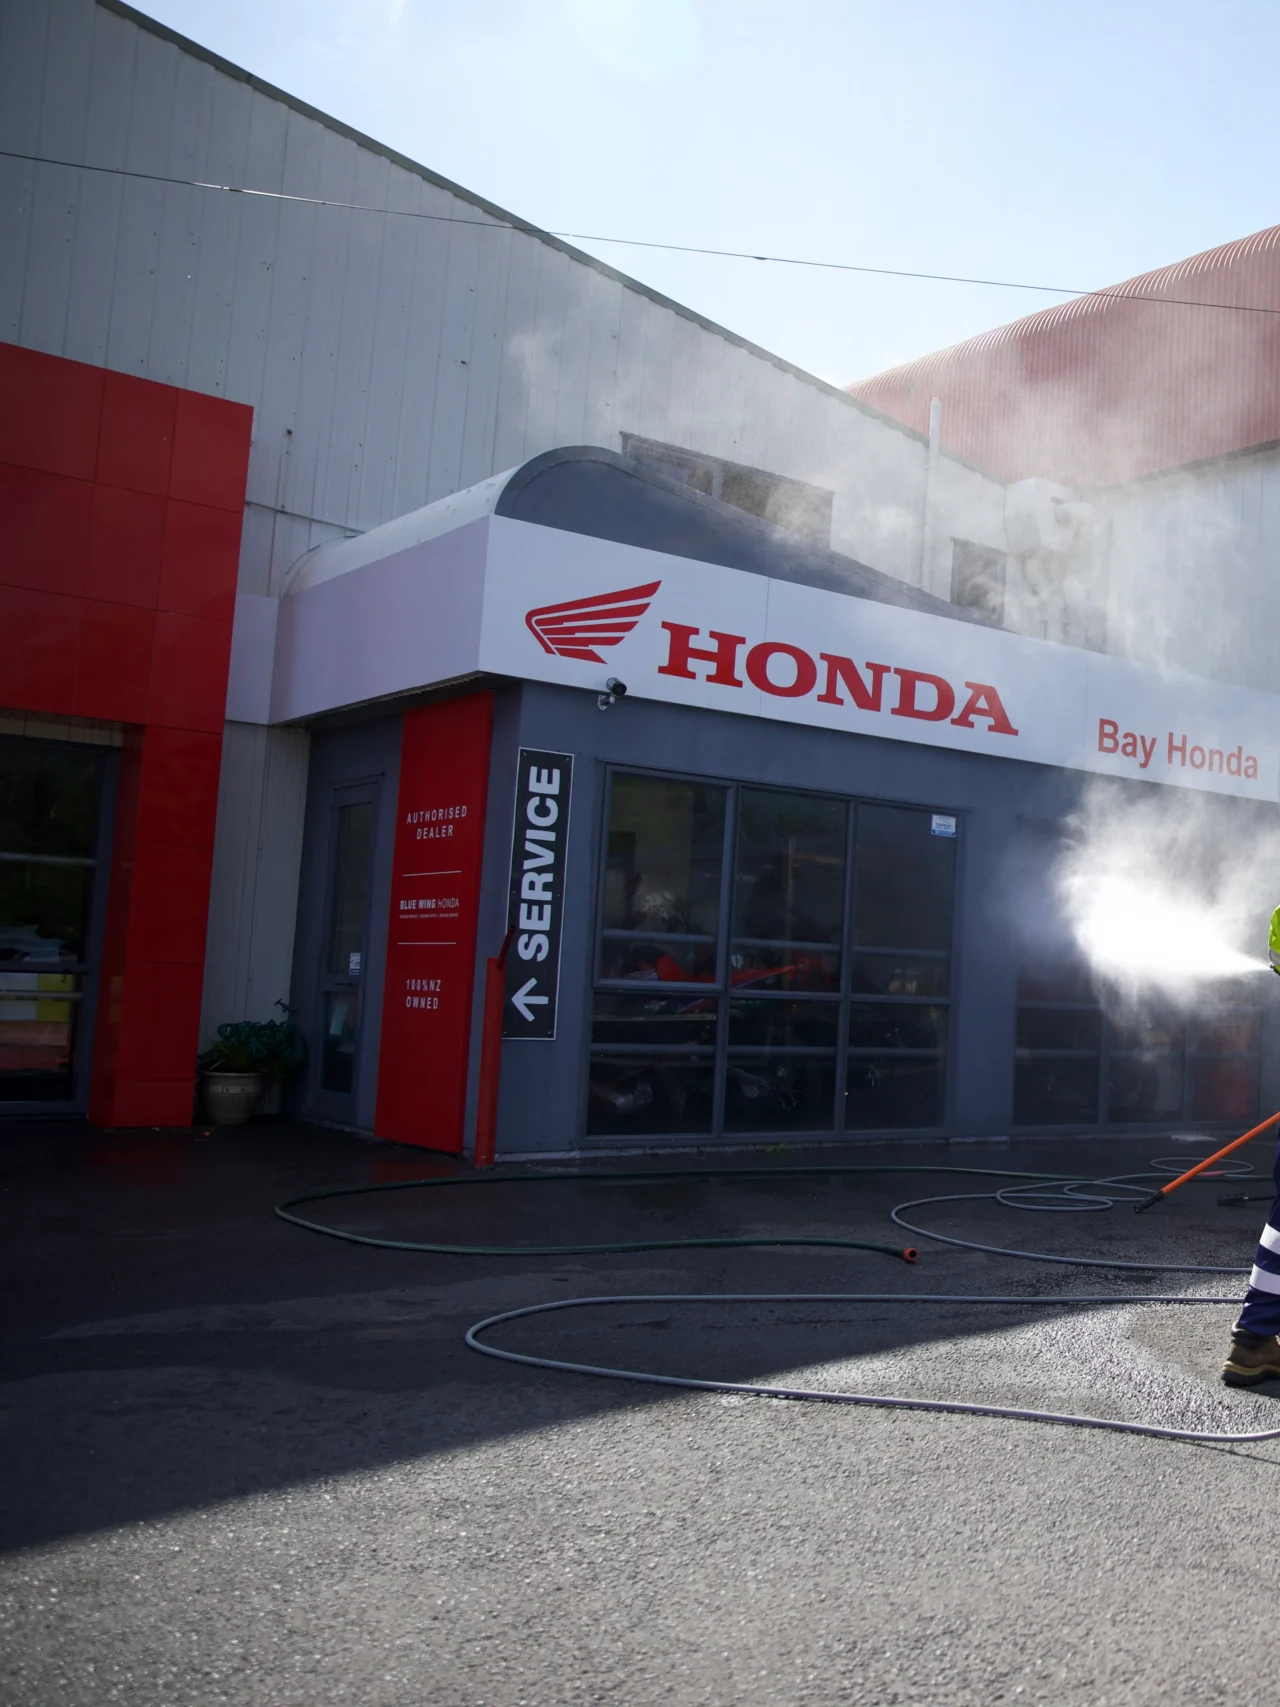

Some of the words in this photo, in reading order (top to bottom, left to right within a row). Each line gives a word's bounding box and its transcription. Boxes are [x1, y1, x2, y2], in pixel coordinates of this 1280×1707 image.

[657, 620, 1019, 736] HONDA
[1098, 718, 1157, 768] Bay
[1167, 731, 1258, 780] Honda
[406, 805, 468, 824] AUTHORISED
[416, 824, 454, 840] DEALER
[517, 766, 561, 962] SERVICE
[400, 899, 417, 910] BLUE
[418, 898, 436, 909] WING
[438, 897, 459, 908] HONDA
[406, 996, 439, 1010] OWNED
